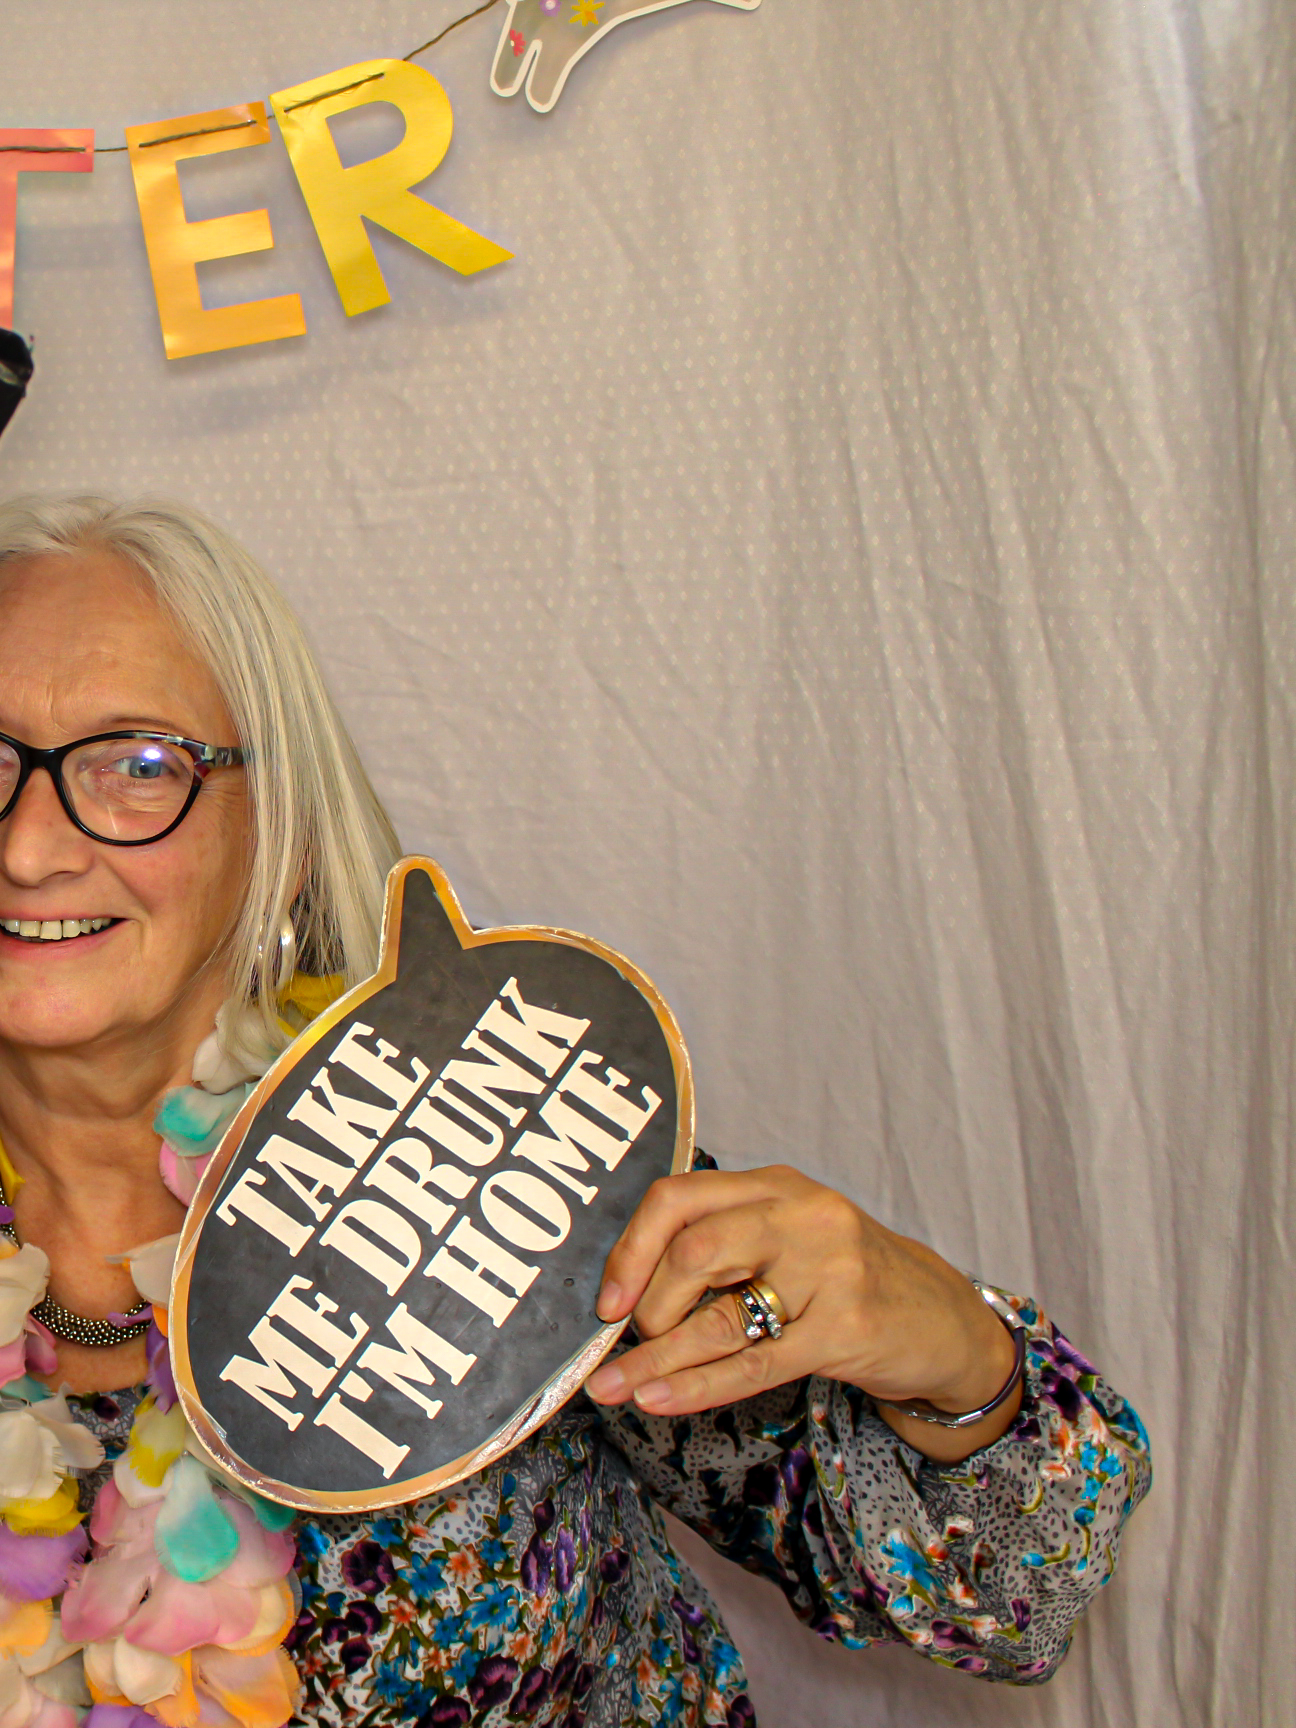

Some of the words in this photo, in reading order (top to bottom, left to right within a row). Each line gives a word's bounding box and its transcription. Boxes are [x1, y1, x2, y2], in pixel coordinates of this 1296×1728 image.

[216, 1021, 430, 1258] TAKE
[219, 1274, 370, 1432] ME
[318, 976, 591, 1297] DRUNK
[313, 1302, 478, 1479] I'M
[422, 1049, 663, 1328] HOME
